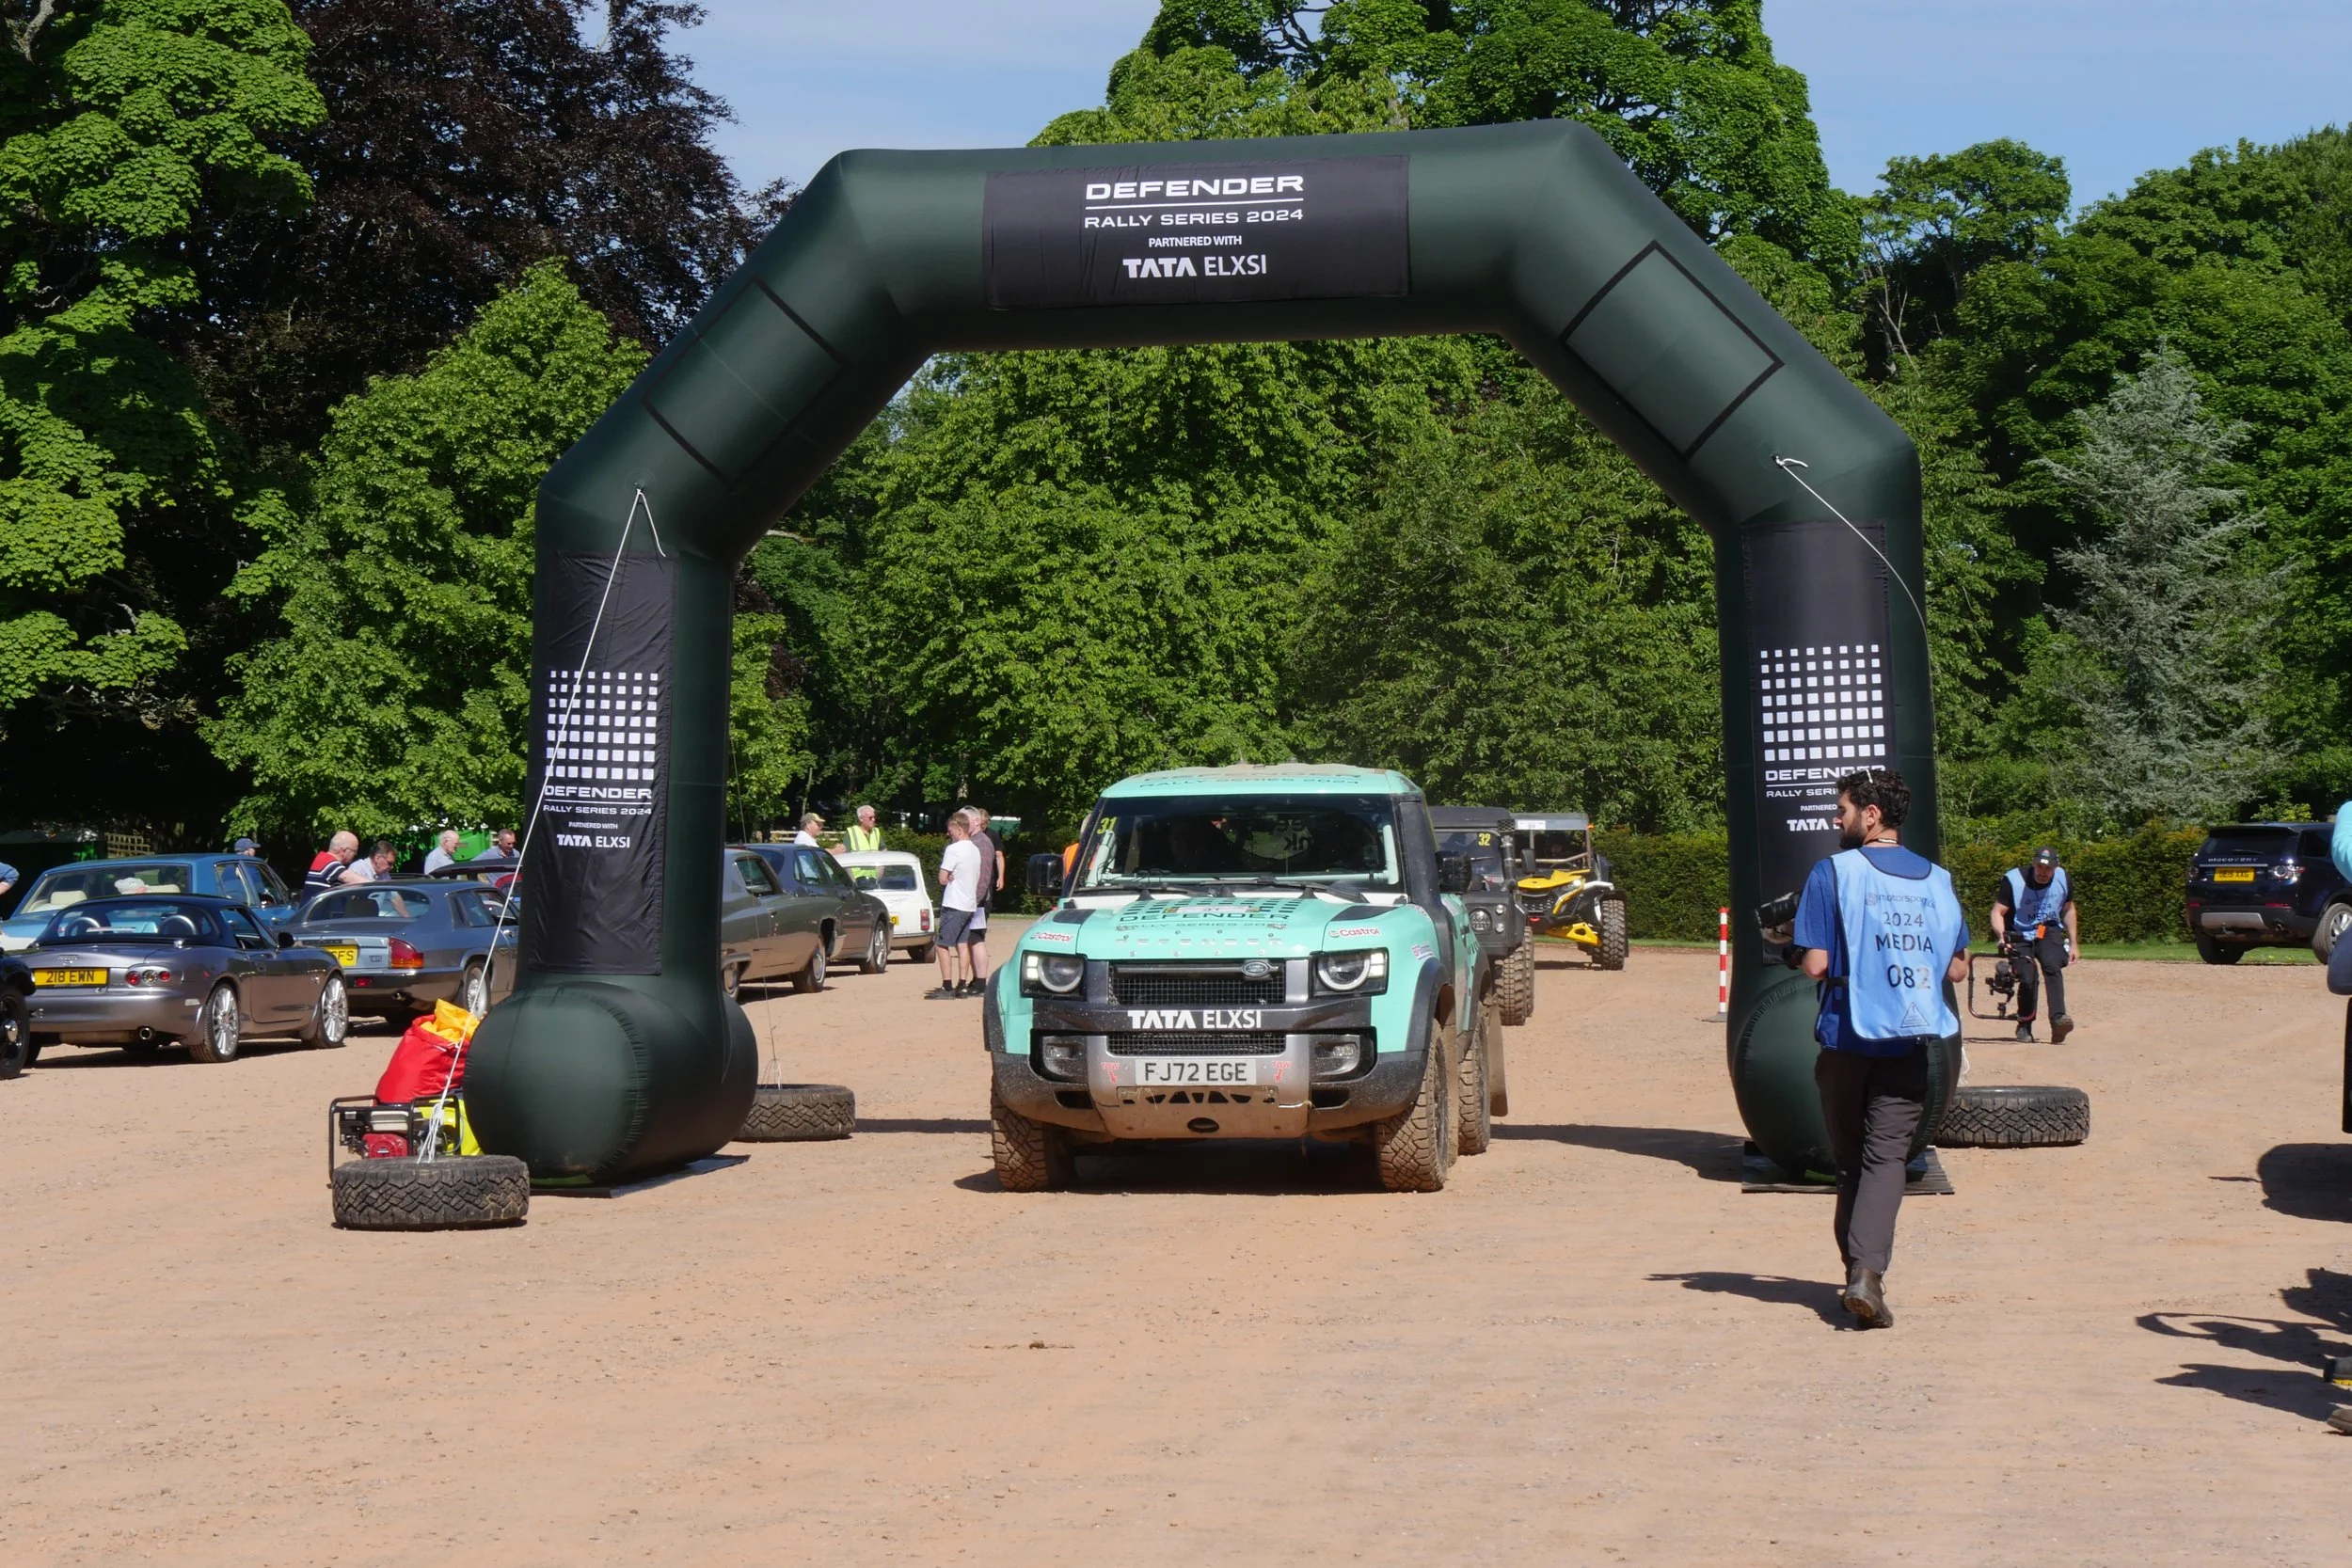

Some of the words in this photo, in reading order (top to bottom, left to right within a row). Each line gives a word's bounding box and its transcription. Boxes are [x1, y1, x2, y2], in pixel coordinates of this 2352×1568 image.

[1086, 175, 1304, 200] DEFENDER
[1085, 214, 1153, 229] RALLY
[1160, 213, 1239, 226] SERIES
[1247, 209, 1304, 224] 2024
[1148, 236, 1212, 248] PARTNERED
[1213, 235, 1242, 247] WITH
[1122, 257, 1198, 278] TATA
[1204, 255, 1267, 277] ELXSI
[544, 784, 652, 800] DEFENDER
[1766, 789, 1803, 799] RALLY
[543, 804, 572, 814] RALLY
[575, 806, 618, 816] SERIES
[1800, 803, 1837, 812] PARTNERED
[1096, 816, 1117, 834] 31
[1786, 817, 1829, 832] TATA
[556, 833, 593, 847] TATA
[595, 835, 630, 848] ELXSI
[1478, 832, 1491, 847] 32
[1120, 912, 1290, 922] DEFENDER
[1883, 911, 1924, 927] 2024
[1038, 932, 1073, 942] Castrol
[1339, 927, 1380, 938] Castrol
[1875, 932, 1934, 954] MEDIA
[46, 971, 66, 983] 218
[70, 971, 95, 983] EWN
[1887, 963, 1931, 990] 082
[1127, 1010, 1196, 1029] TATA
[1202, 1009, 1262, 1029] ELXSI
[1101, 1062, 1120, 1070] TOW
[1272, 1060, 1292, 1069] TOW
[1144, 1063, 1200, 1082] FJ72
[1206, 1063, 1248, 1081] EGE
